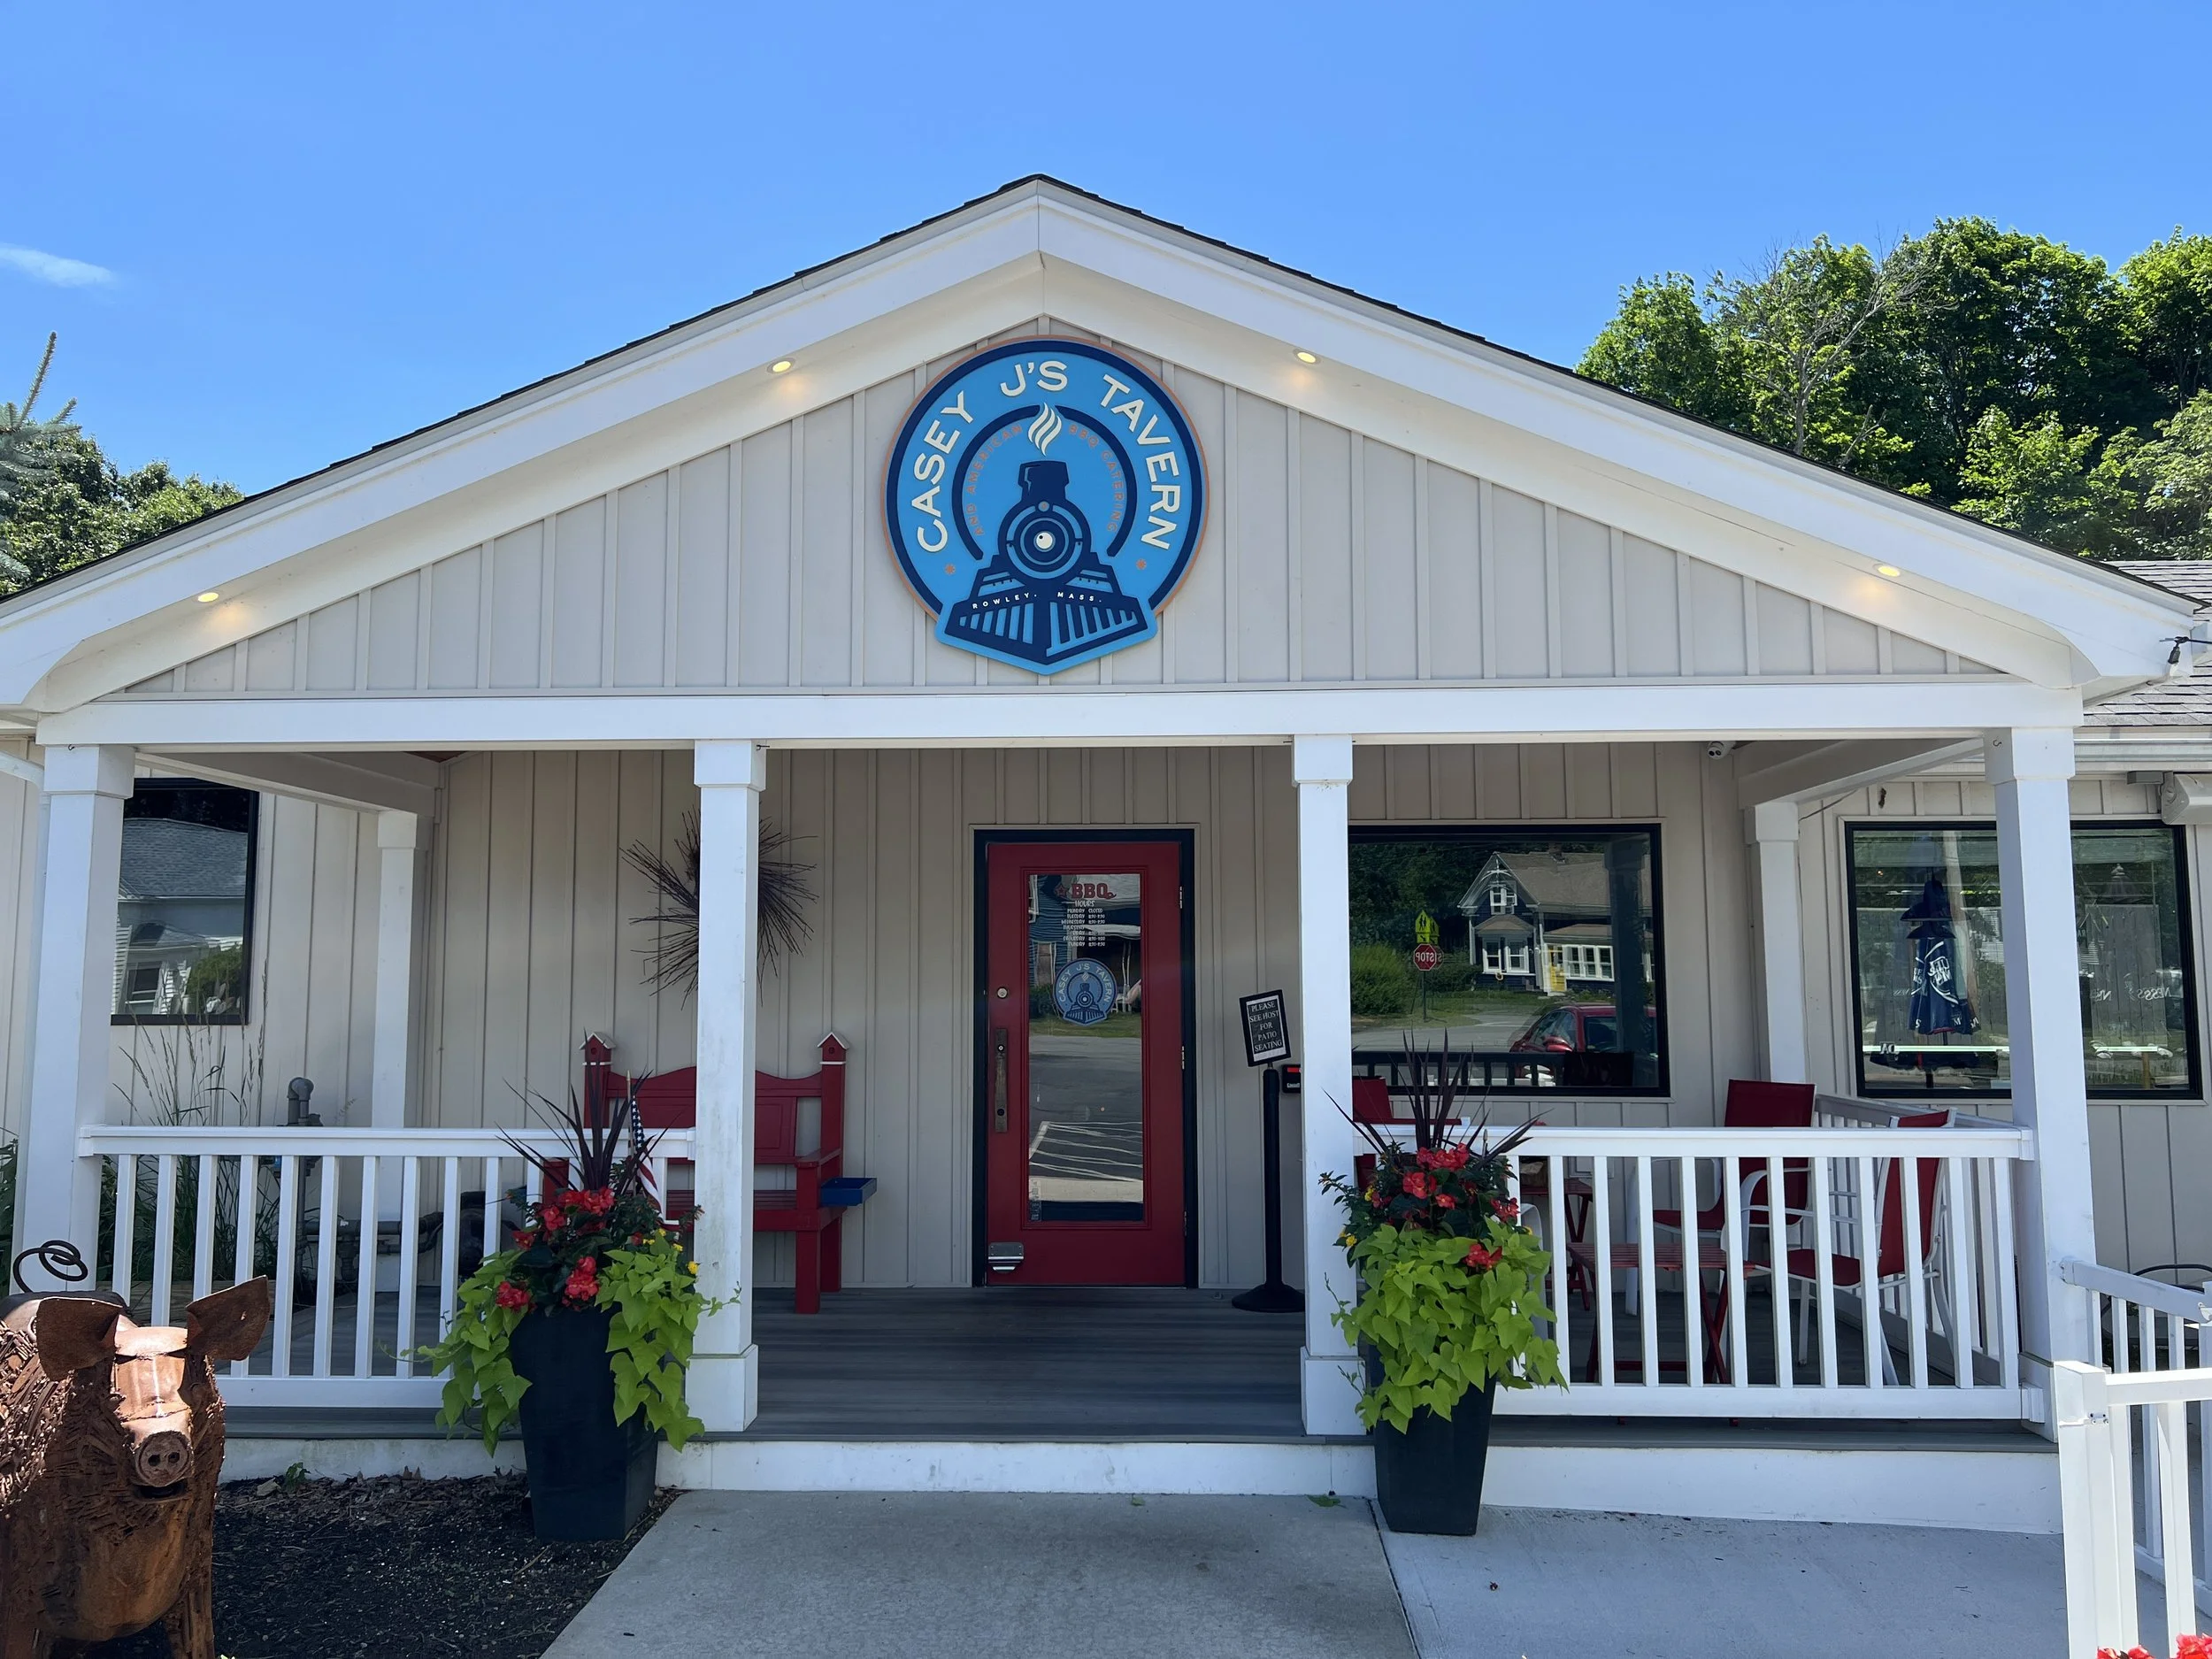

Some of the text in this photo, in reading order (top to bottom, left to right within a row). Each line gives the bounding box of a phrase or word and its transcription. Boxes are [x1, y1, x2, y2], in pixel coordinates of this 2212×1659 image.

[911, 360, 1181, 553] CASEY J'S TAVERN
[966, 425, 1023, 495] AMERICAN
[1069, 424, 1099, 449] BBQ
[1101, 449, 1125, 532] CATERING
[1057, 591, 1102, 603] MASS.
[1071, 883, 1117, 900] BBQ
[1058, 970, 1071, 1002] CASEY
[1095, 966, 1112, 1002] TAVERN
[1251, 1001, 1276, 1012] PLEASE
[1249, 1010, 1279, 1022] SEE HOST
[1259, 1022, 1273, 1031] FOR
[1257, 1031, 1278, 1041] PATIO
[1254, 1039, 1282, 1052] SEATING
